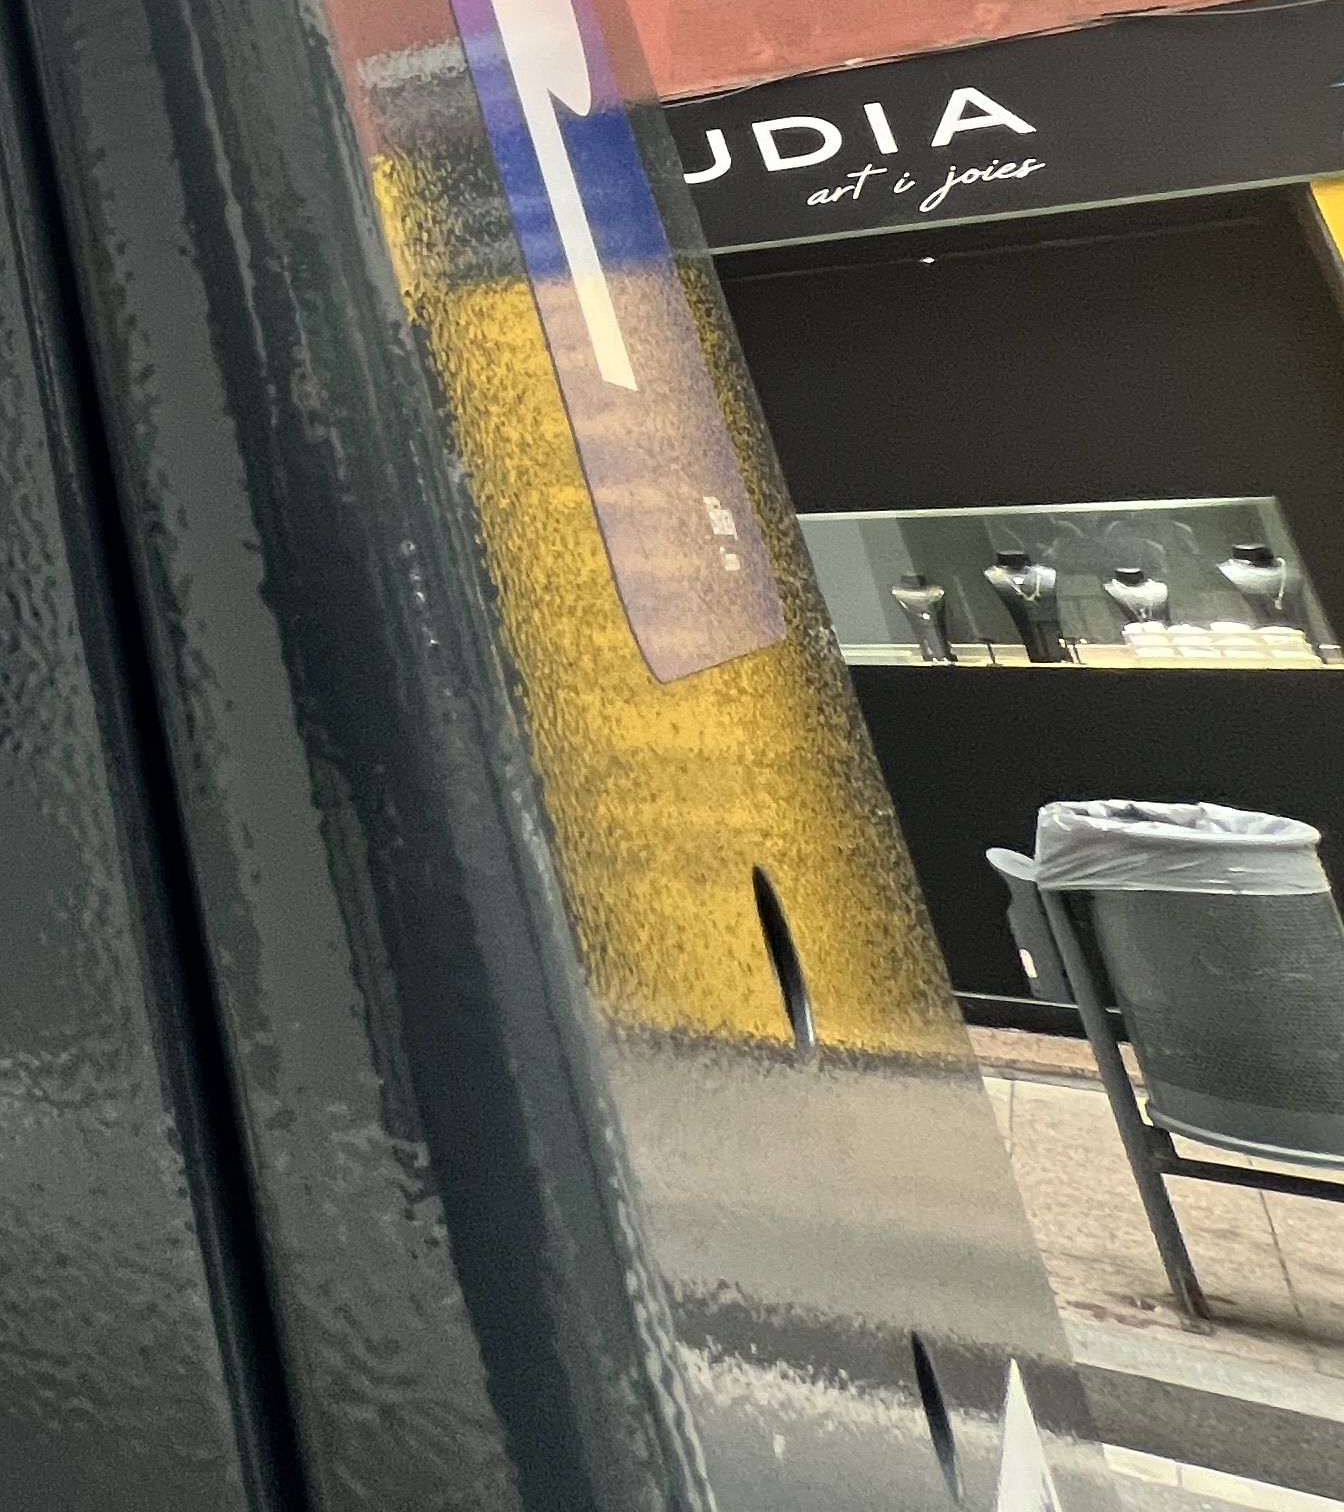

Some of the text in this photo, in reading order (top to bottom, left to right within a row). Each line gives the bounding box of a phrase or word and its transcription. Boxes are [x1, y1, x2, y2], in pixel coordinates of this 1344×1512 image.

[806, 156, 1046, 213] art i joies
